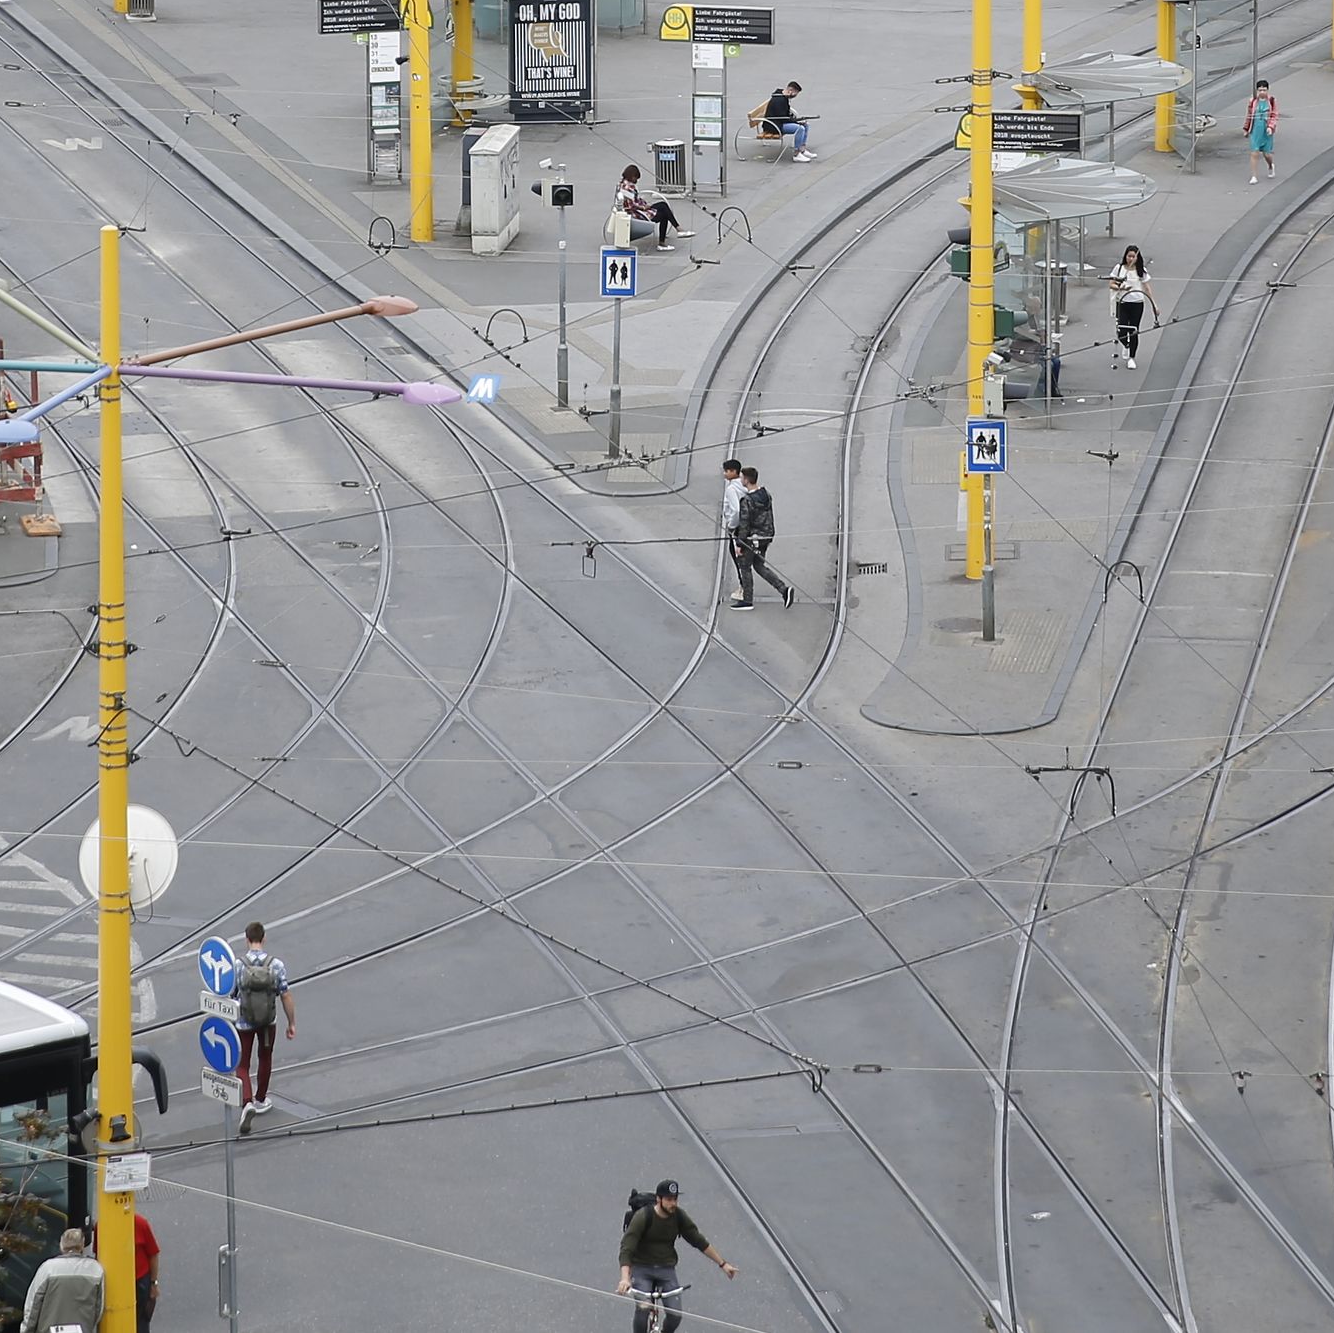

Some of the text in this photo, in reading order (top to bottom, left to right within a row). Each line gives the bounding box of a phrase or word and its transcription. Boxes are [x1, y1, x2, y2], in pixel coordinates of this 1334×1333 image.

[519, 3, 580, 22] OH, MY GOD
[728, 46, 737, 55] C
[527, 66, 574, 79] THAT'S WINE!
[218, 1001, 234, 1016] Taxi
